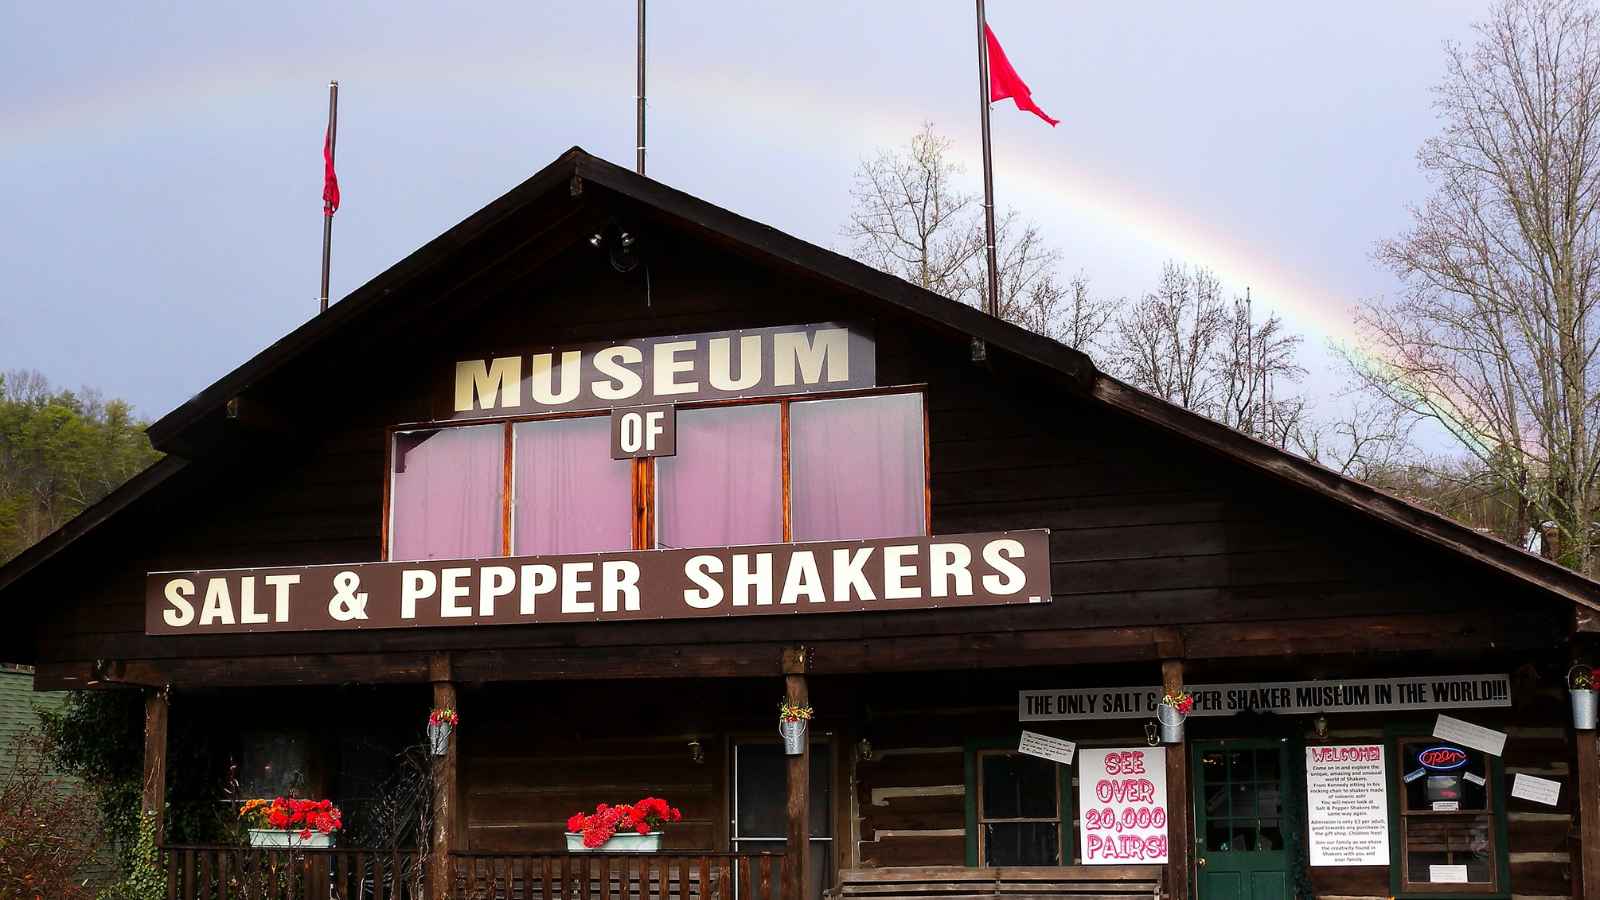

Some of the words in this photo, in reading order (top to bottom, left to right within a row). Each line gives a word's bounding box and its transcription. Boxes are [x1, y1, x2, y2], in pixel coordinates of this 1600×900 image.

[455, 328, 849, 412] MUSEUM
[620, 411, 664, 453] OF
[163, 574, 301, 627] SALT
[328, 571, 369, 621] &
[401, 561, 641, 619] PEPPER
[684, 539, 1027, 609] SHAKERS
[1025, 695, 1053, 715] THE
[1057, 694, 1098, 714] ONLY
[1103, 692, 1142, 713] SALT
[1227, 687, 1291, 710] SHAKER
[1296, 684, 1370, 708] MUSEUM
[1374, 684, 1392, 705] IN
[1397, 683, 1427, 704] THE
[1432, 680, 1508, 703] WORLD!!!
[1104, 751, 1146, 775] SEE
[1311, 746, 1380, 762] WELCOME!
[1096, 778, 1155, 805] OVER
[1085, 806, 1166, 833] 20,000
[1087, 833, 1167, 861] PAIRS!
